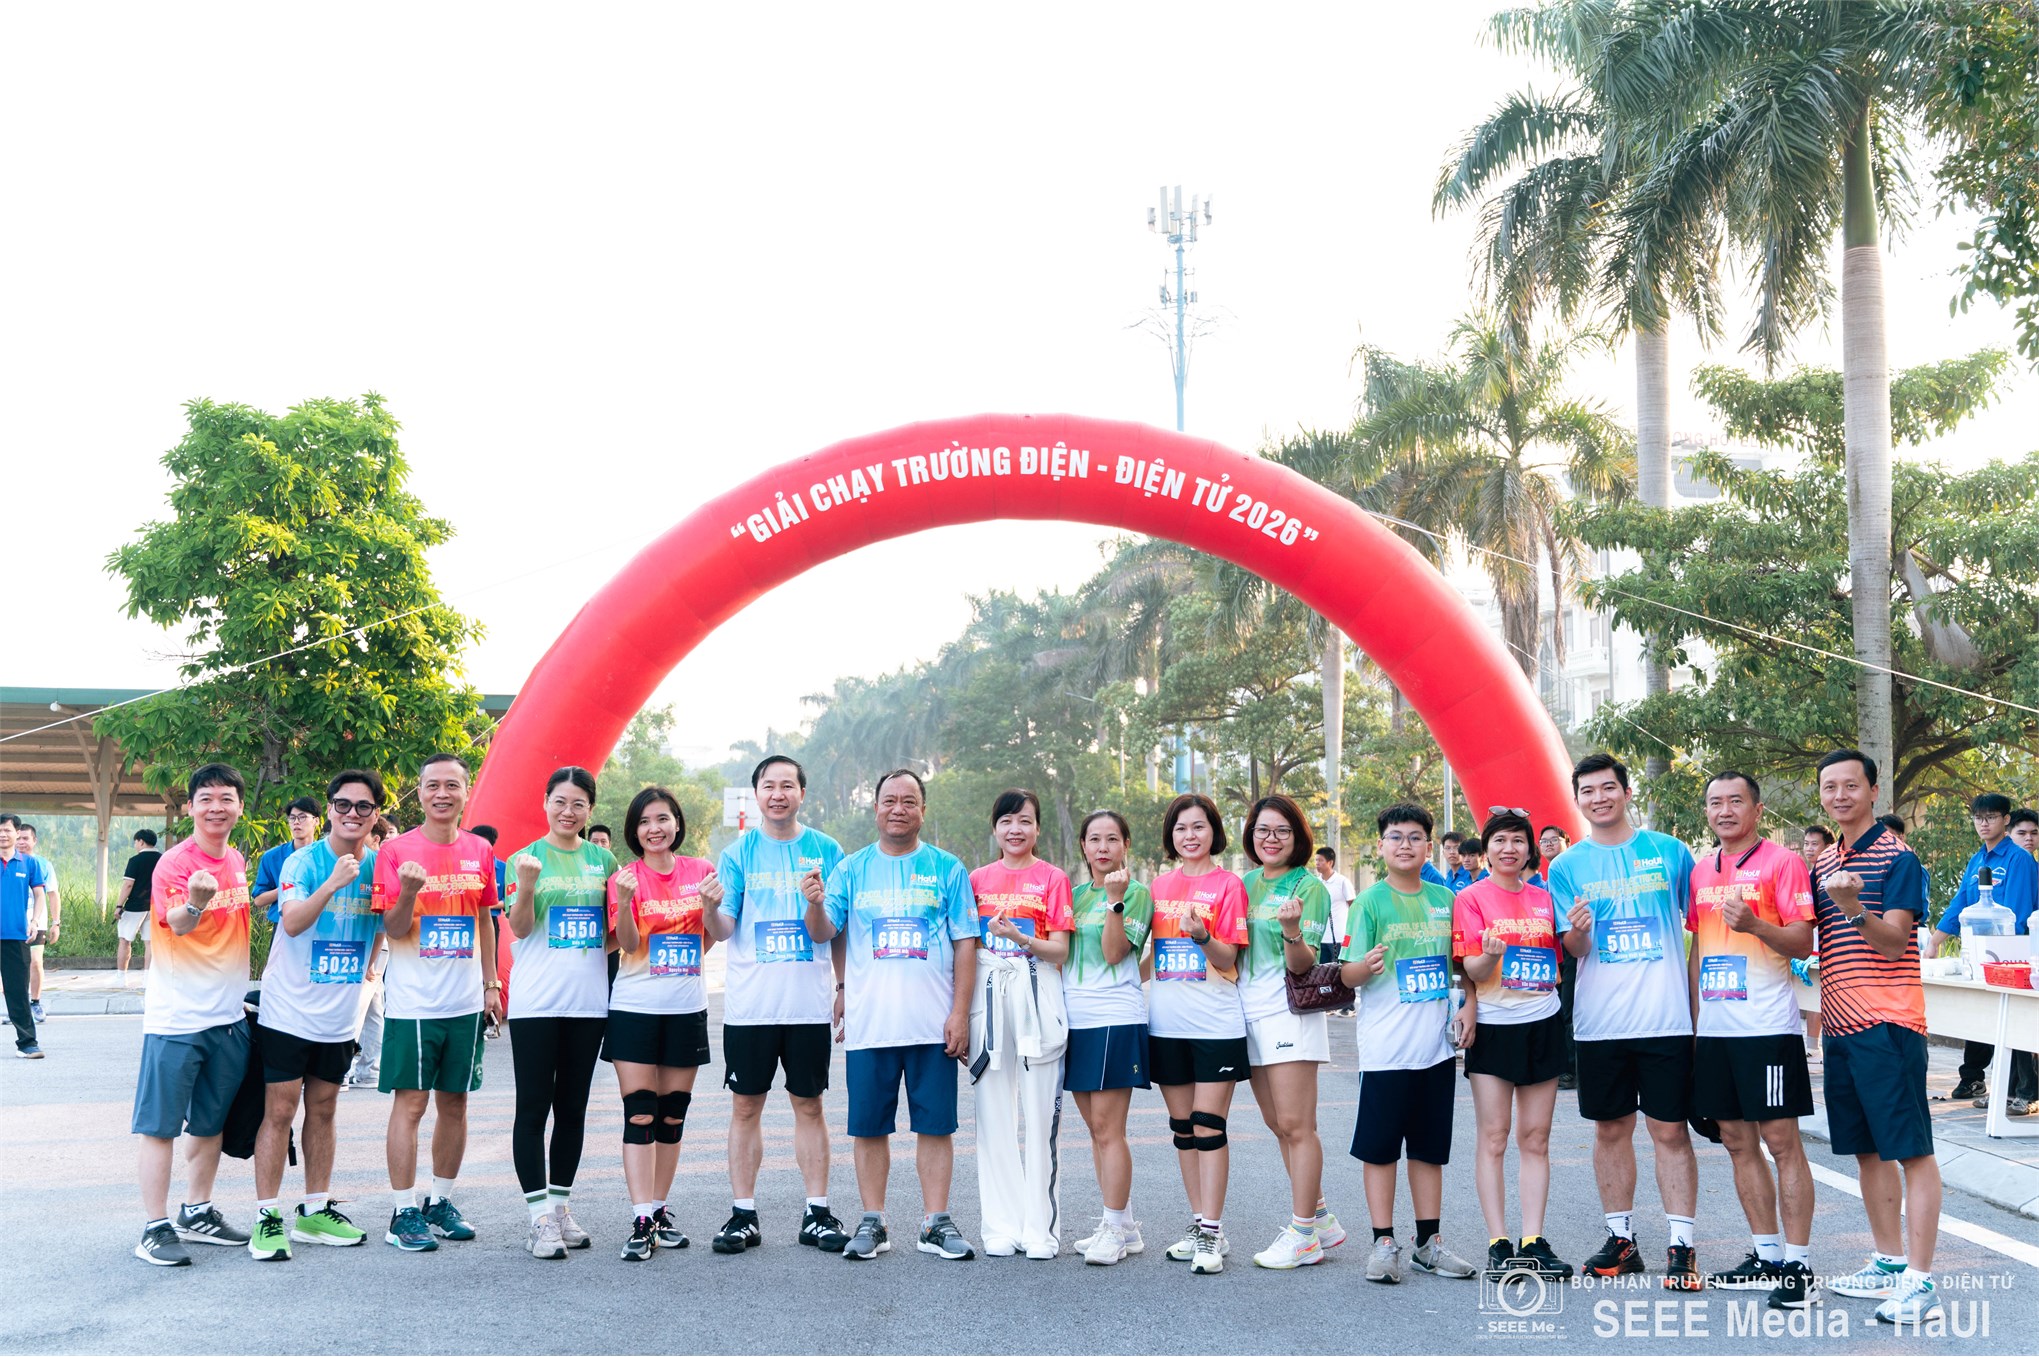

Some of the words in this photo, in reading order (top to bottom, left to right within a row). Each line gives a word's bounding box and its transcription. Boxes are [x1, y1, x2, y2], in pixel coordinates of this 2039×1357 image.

[730, 491, 809, 543] “GIẢI
[809, 463, 885, 512] CHẠY
[891, 440, 1011, 488] TRƯỜNG
[1019, 441, 1090, 481] ĐIỆN
[1115, 455, 1186, 500] ĐIỆN
[1191, 473, 1234, 513] TỬ
[1228, 493, 1320, 546] 2026”
[805, 857, 823, 865] HaUI
[1641, 857, 1662, 866] HaUI
[917, 874, 937, 883] HaUI
[558, 920, 597, 939] 1550
[1493, 919, 1517, 928] SCHOOL
[428, 930, 470, 948] 2548
[766, 934, 805, 952] 5011
[878, 930, 922, 948] 6868
[1607, 931, 1652, 952] 5014
[319, 956, 359, 974] 5023
[657, 948, 697, 966] 2547
[1158, 953, 1198, 971] 2556
[1510, 961, 1550, 981] 2523
[1702, 970, 1738, 989] 2558
[1405, 971, 1445, 992] 5032
